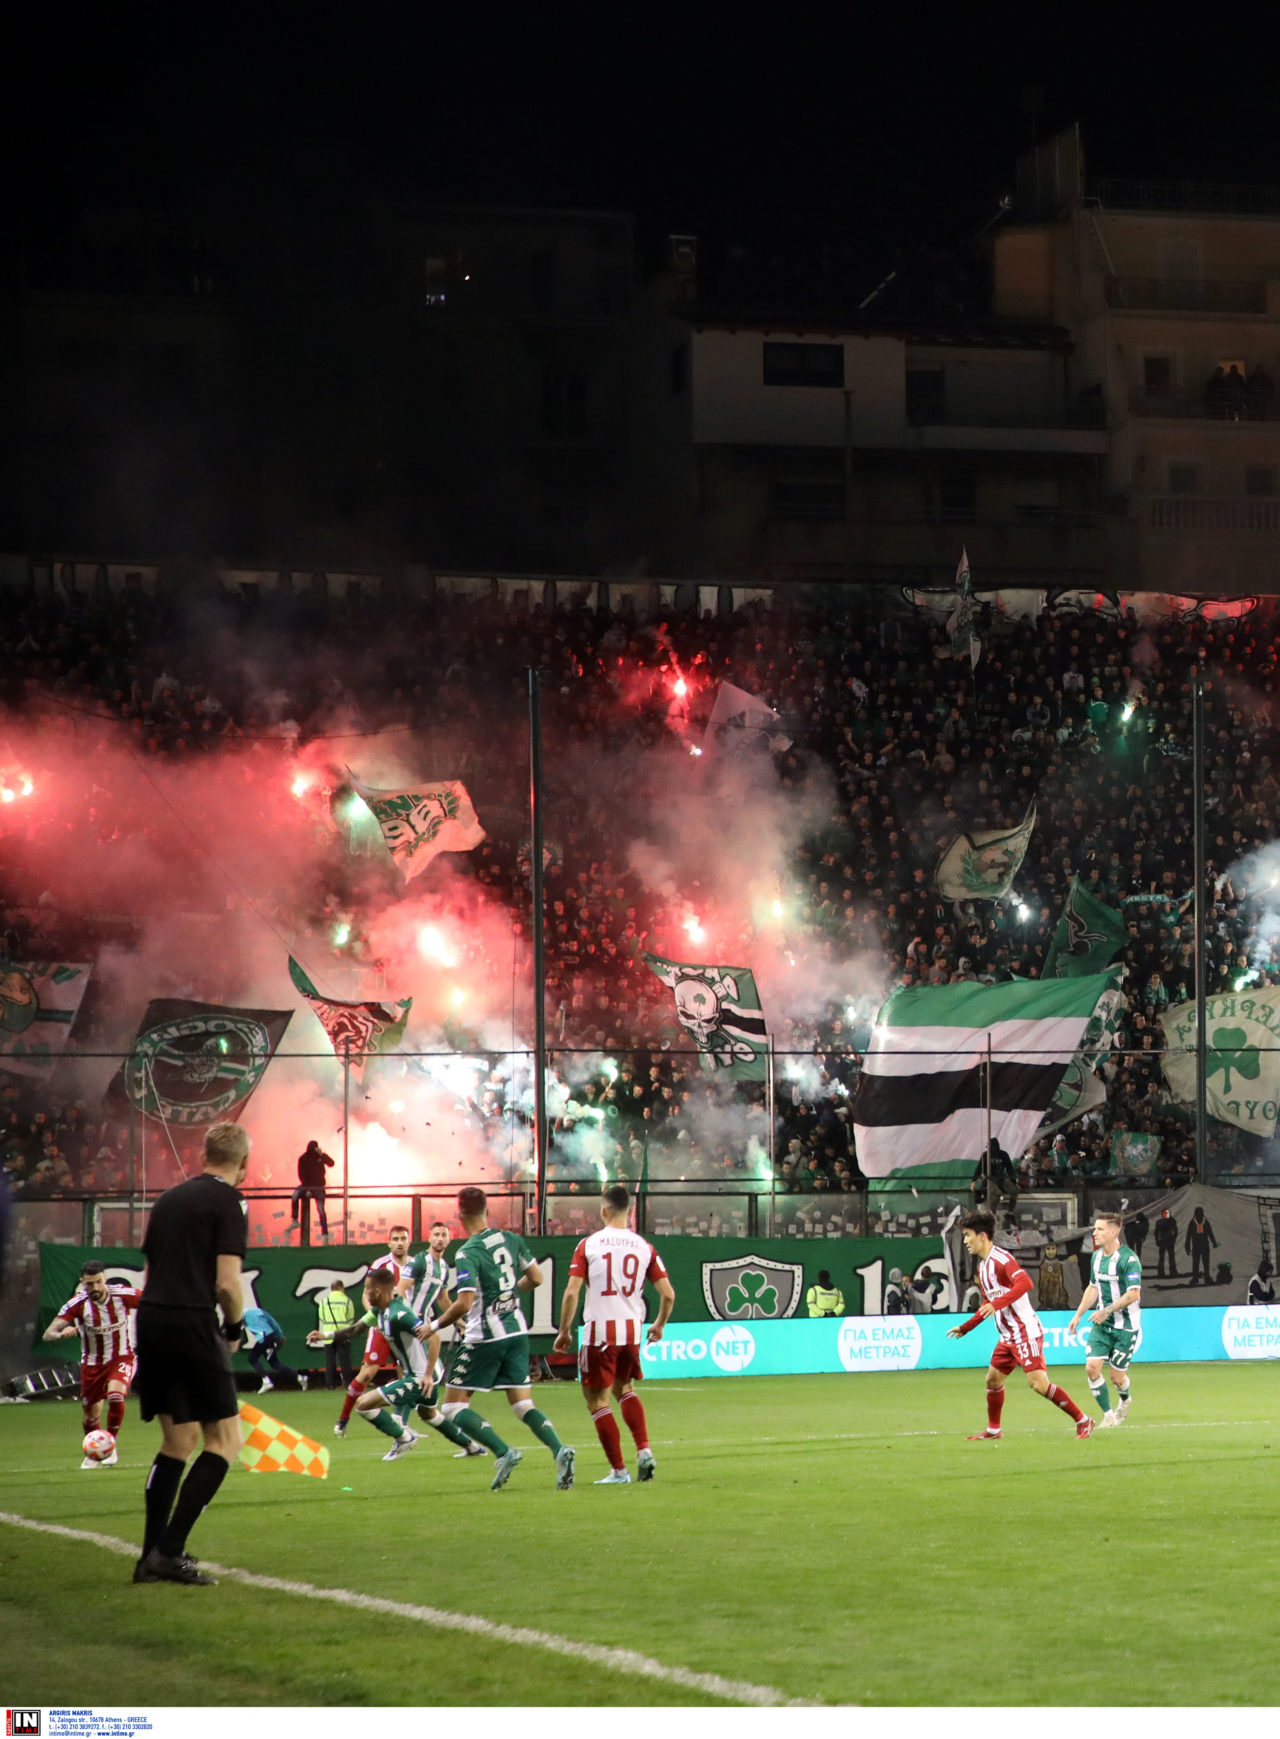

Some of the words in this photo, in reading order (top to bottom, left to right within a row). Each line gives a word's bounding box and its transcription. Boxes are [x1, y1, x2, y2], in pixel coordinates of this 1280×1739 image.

[493, 1246, 516, 1291] 3
[601, 1252, 640, 1298] 19
[1228, 1317, 1250, 1330] ΓΙΑ
[844, 1329, 867, 1342] ΓΙΑ
[872, 1327, 915, 1341] ΕΜΑΣ
[716, 1340, 750, 1356] NET
[849, 1345, 911, 1360] ΜΕΤΡΑΣ
[1113, 1350, 1125, 1365] 77
